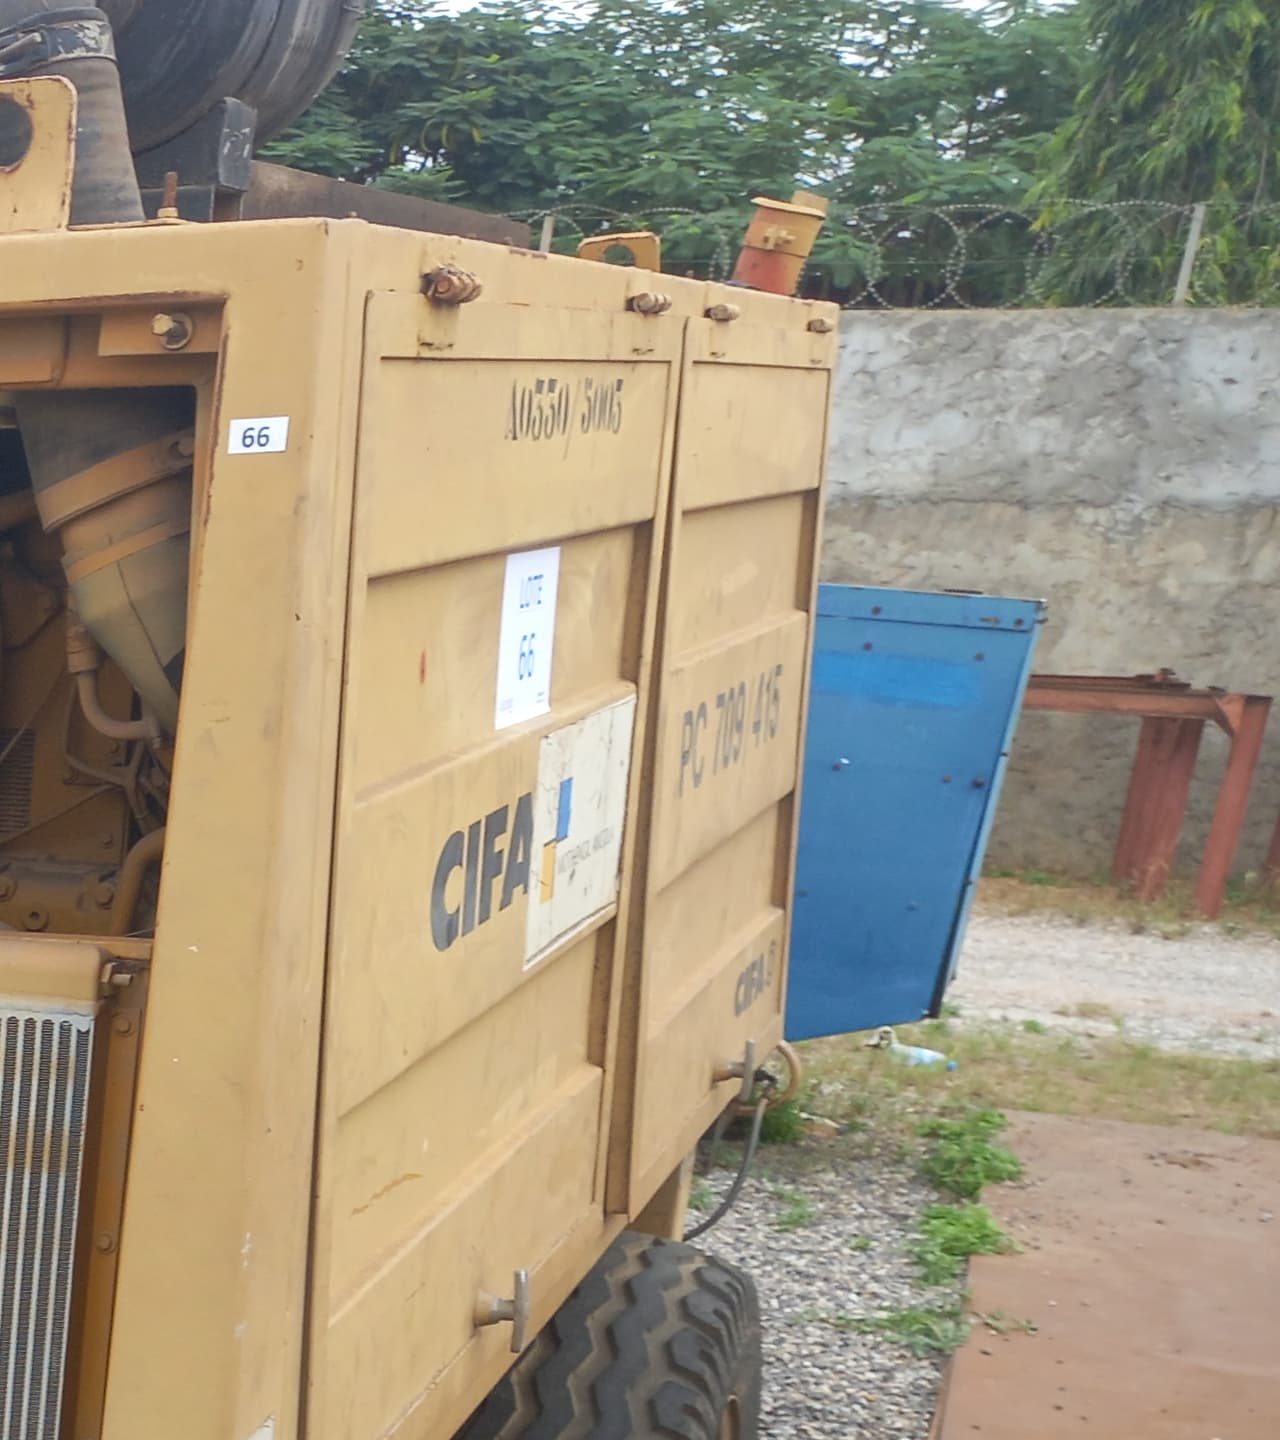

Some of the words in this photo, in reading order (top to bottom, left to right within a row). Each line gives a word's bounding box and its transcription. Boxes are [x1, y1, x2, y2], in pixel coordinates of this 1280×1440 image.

[241, 426, 270, 448] 66
[520, 574, 544, 609] LOTE
[518, 632, 536, 680] 66
[678, 701, 708, 799] PC
[430, 792, 534, 952] CIFA
